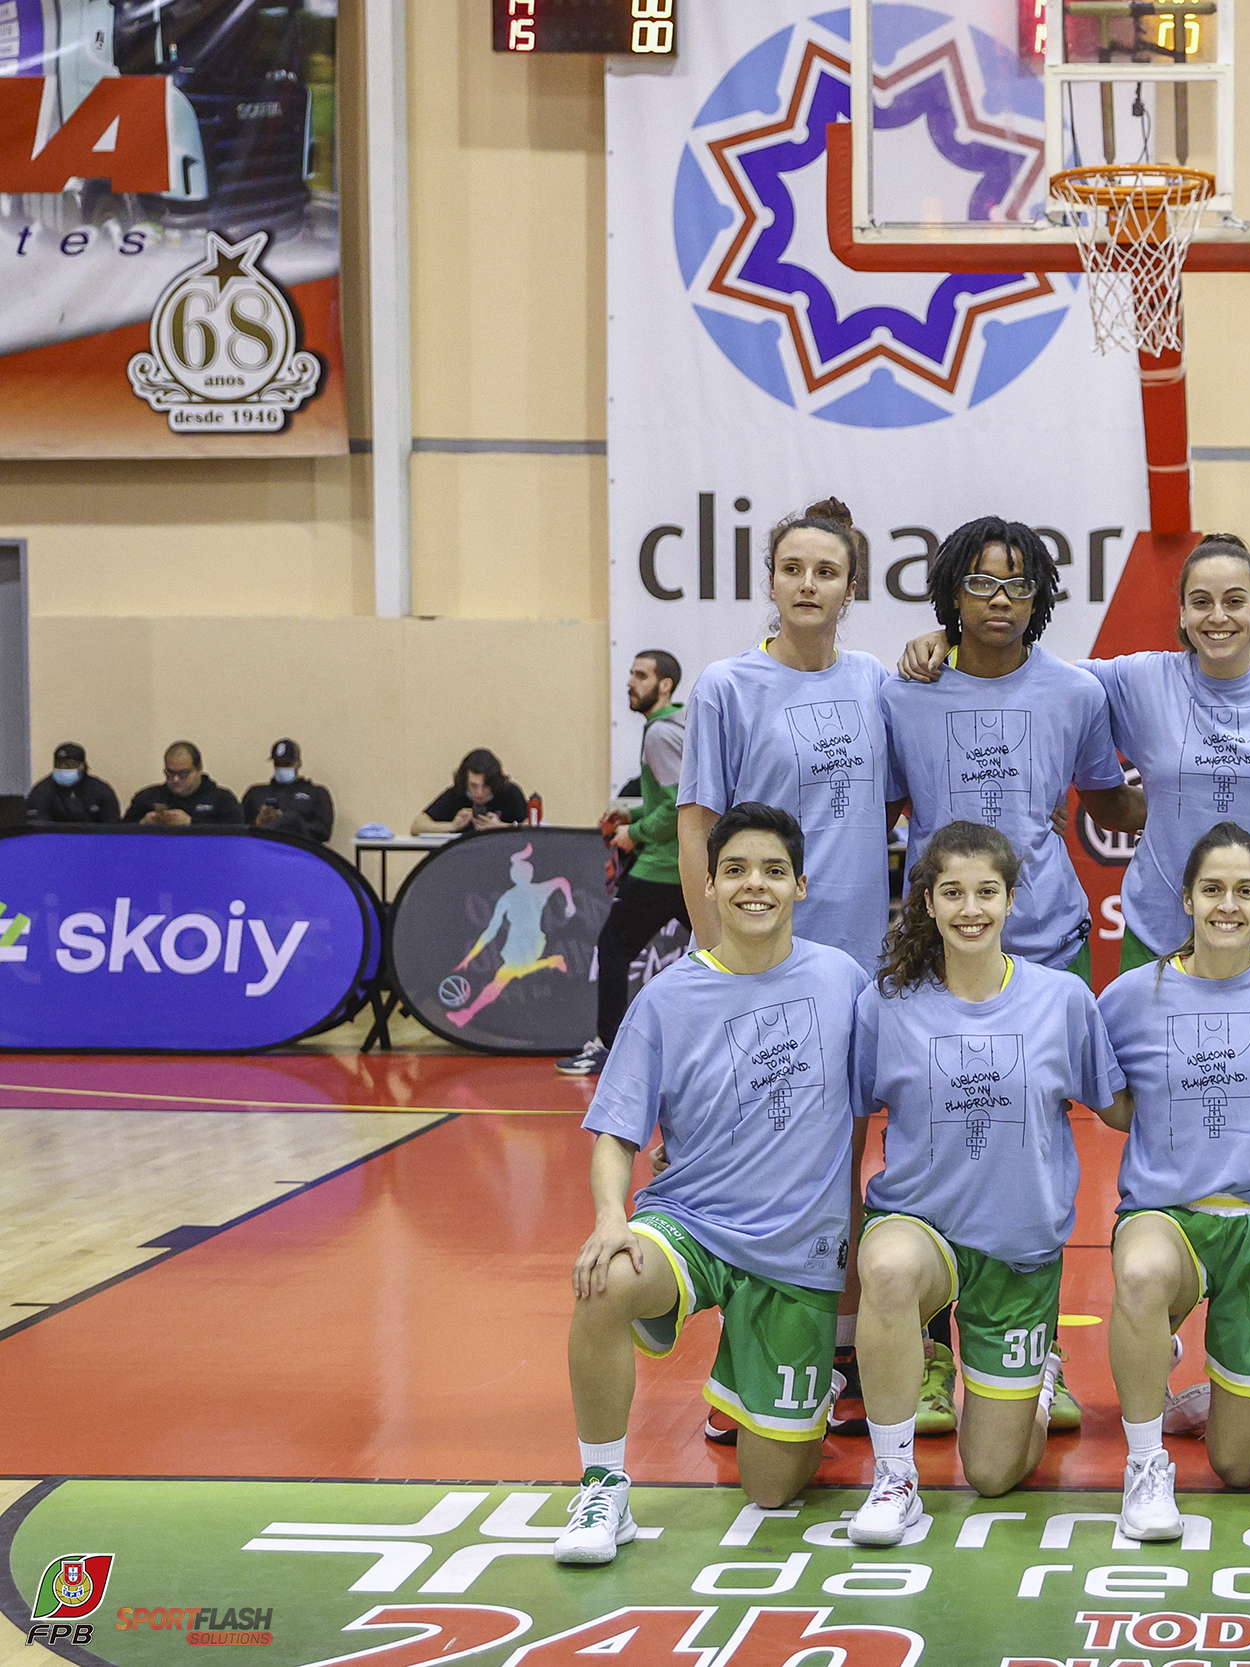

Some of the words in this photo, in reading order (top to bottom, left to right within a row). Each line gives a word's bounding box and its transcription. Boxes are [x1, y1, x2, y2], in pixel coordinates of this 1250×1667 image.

[169, 287, 277, 371] 68
[203, 375, 246, 386] anos
[174, 408, 224, 423] desde
[231, 408, 278, 423] 1946
[823, 749, 835, 759] TO
[836, 746, 848, 758] MY
[1213, 745, 1224, 754] TO
[1225, 744, 1237, 755] MY
[976, 759, 988, 768] TO
[989, 757, 1001, 768] MY
[56, 897, 310, 997] skoiy
[764, 1060, 777, 1070] TO
[778, 1053, 791, 1066] MY
[1198, 1064, 1211, 1074] TO
[1213, 1061, 1226, 1074] MY
[962, 1086, 976, 1097] TO
[977, 1084, 991, 1097] MY
[1002, 1322, 1048, 1369] 30
[773, 1364, 819, 1410] 11
[690, 1552, 934, 1597] da
